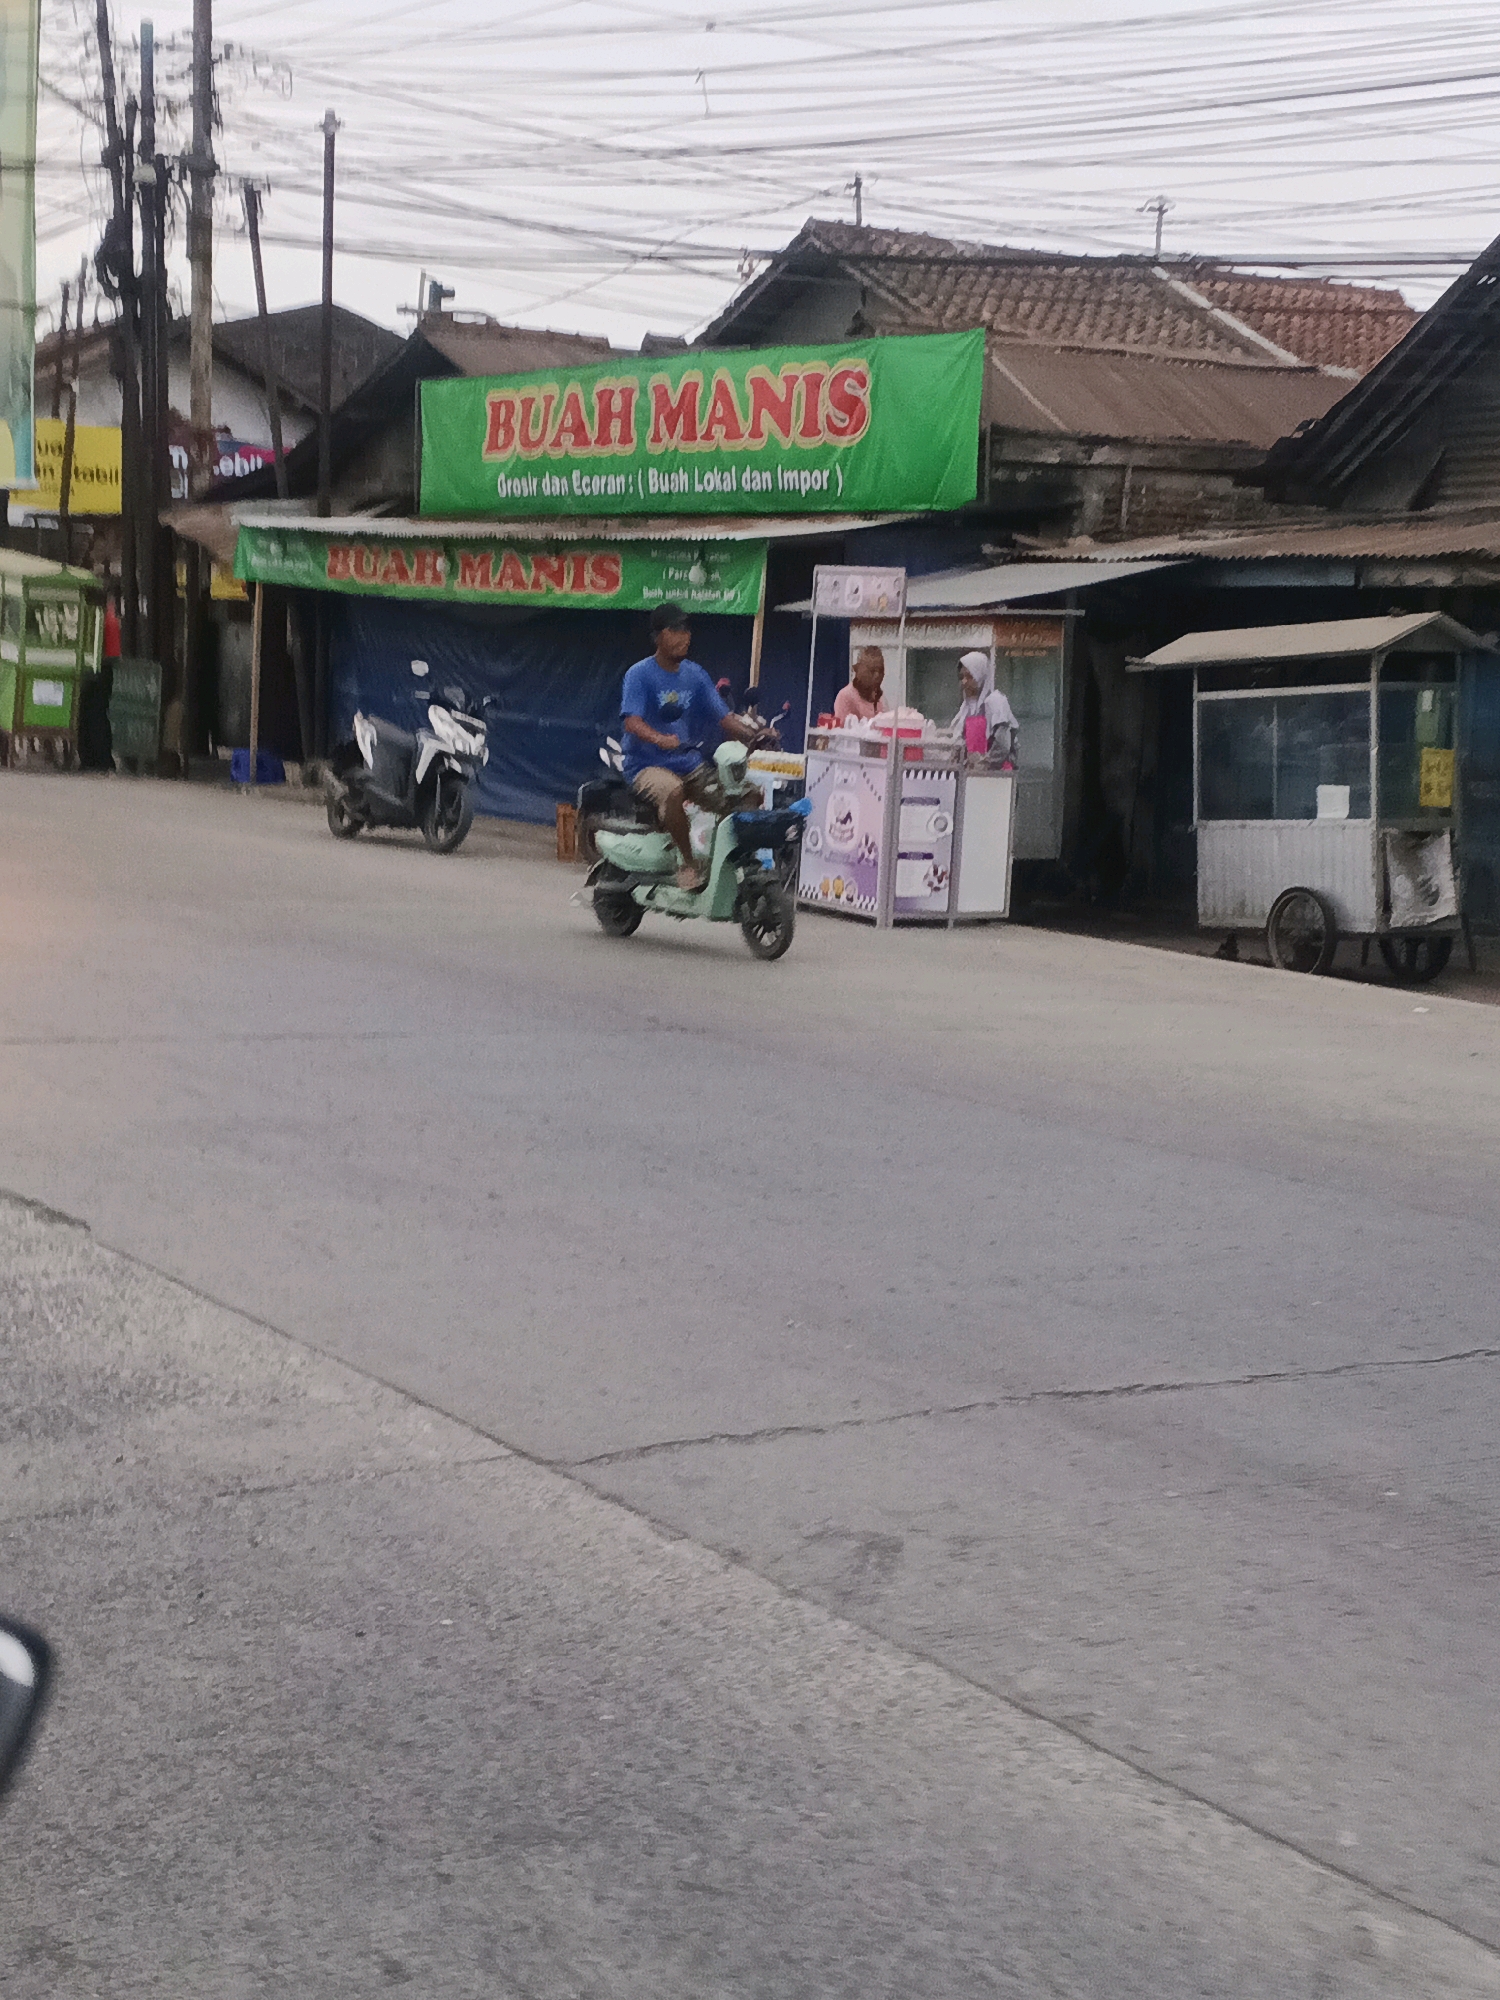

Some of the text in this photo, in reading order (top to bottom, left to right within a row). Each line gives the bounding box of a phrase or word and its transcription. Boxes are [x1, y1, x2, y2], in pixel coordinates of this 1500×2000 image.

[483, 358, 872, 461] BUAH MANIS
[541, 470, 569, 497] dan
[648, 466, 689, 494] Buah
[694, 465, 737, 493] Lokal
[741, 464, 773, 492] dan
[777, 463, 830, 498] Impor
[326, 544, 622, 596] BUAH MANIS
